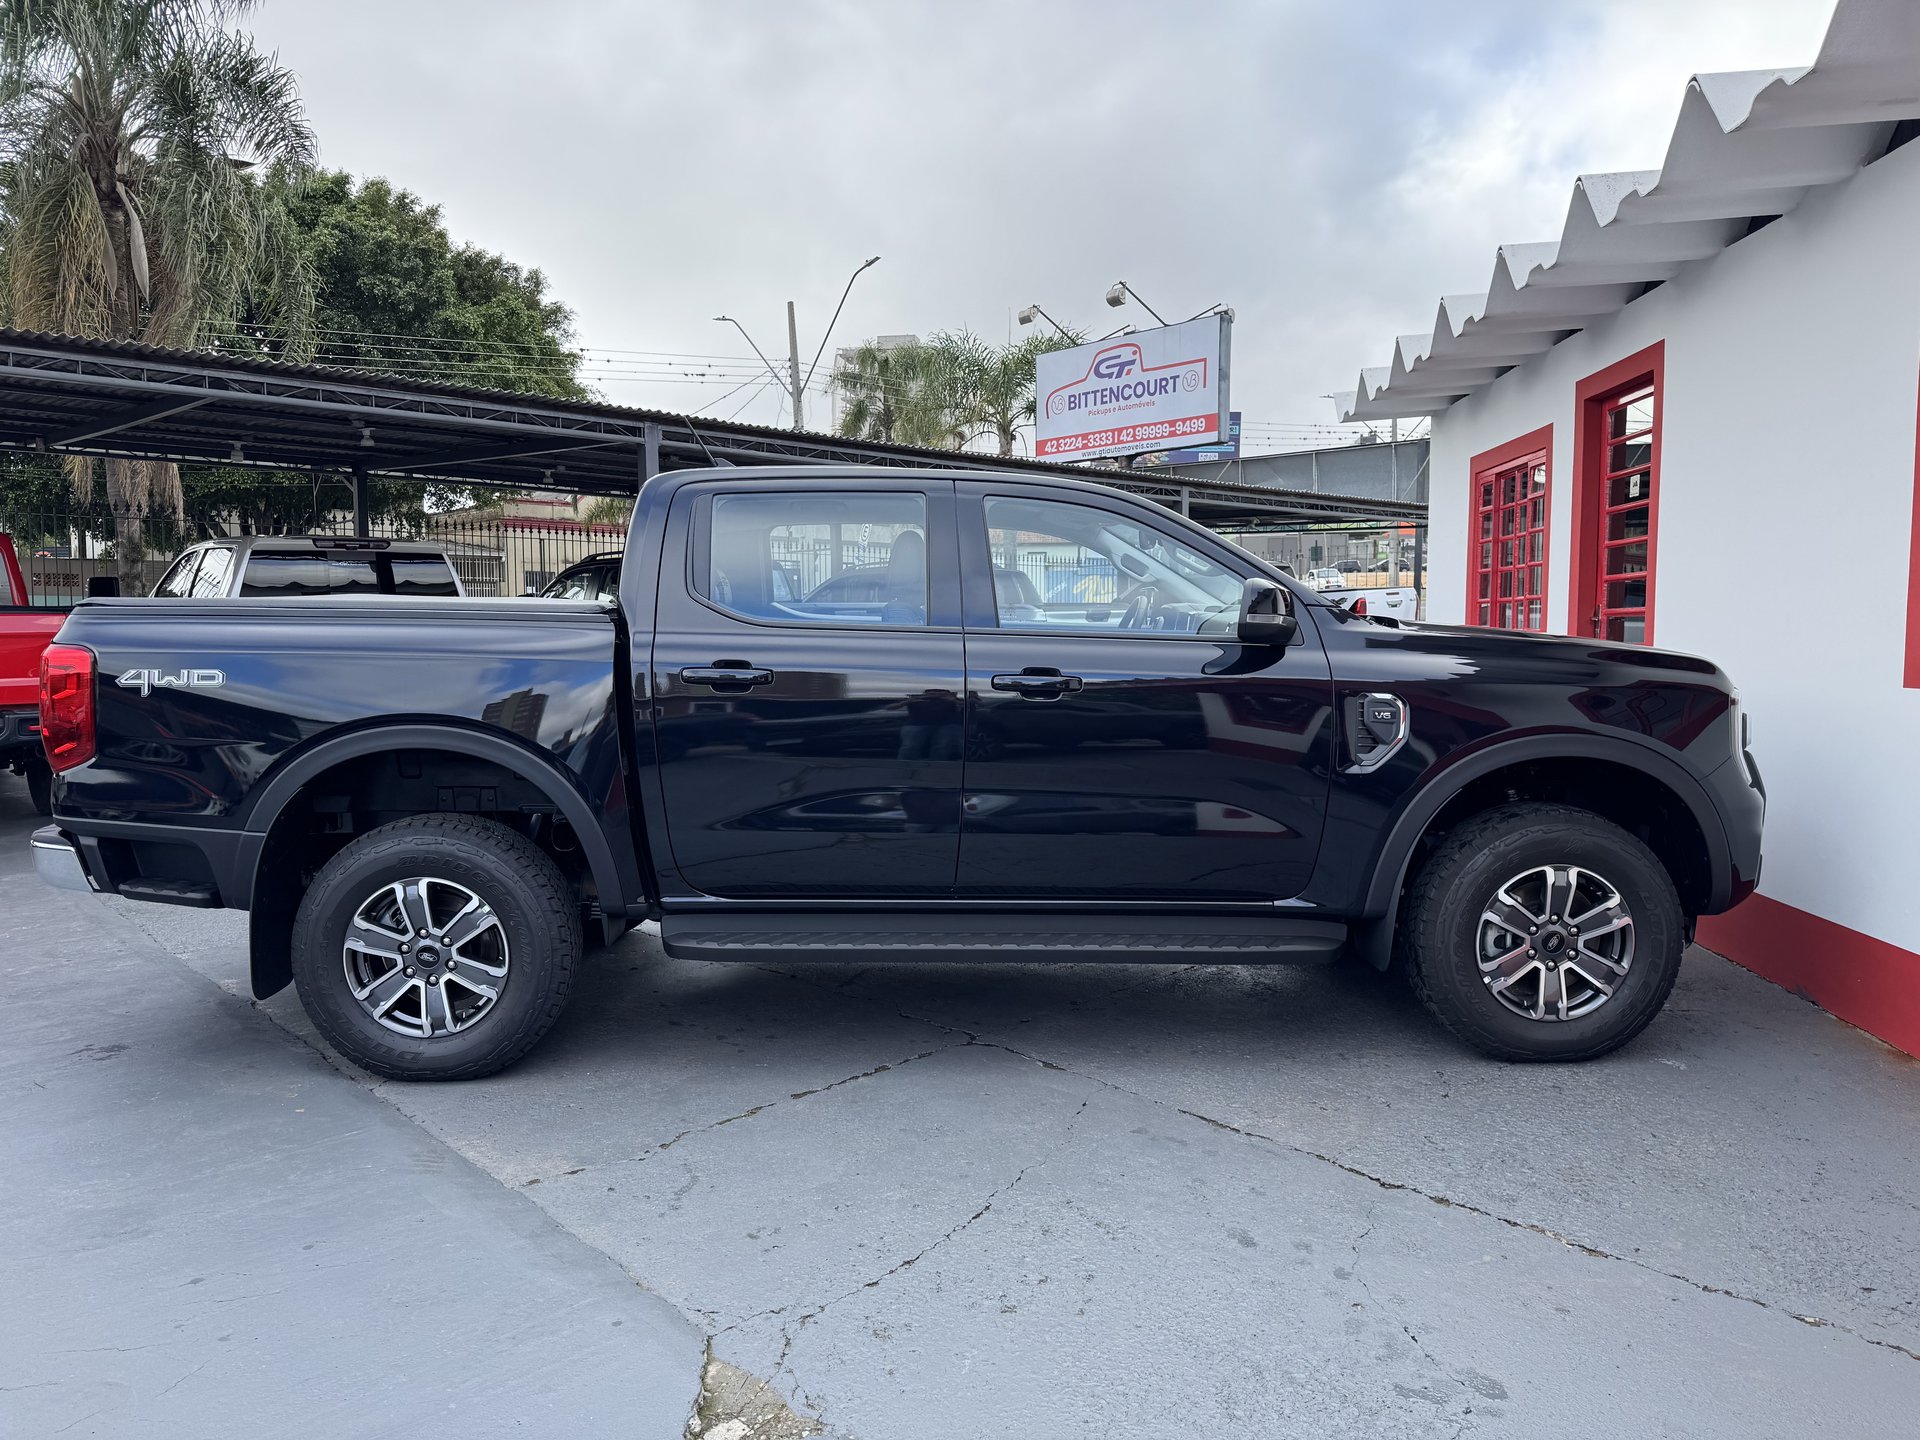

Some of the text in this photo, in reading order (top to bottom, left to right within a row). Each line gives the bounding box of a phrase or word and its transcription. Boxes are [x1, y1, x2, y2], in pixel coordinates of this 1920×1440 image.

[1067, 374, 1180, 411] BITTENCOURT
[1088, 407, 1112, 417] Pickups
[1117, 400, 1156, 412] Automóveis
[1045, 440, 1058, 453] 42
[1058, 431, 1113, 451] 3224-3333
[1120, 428, 1134, 442] 42
[1135, 417, 1206, 440] 99999-9499
[1081, 441, 1161, 458] www.gtiautomoveis.com
[115, 669, 226, 697] 4WD
[1374, 711, 1391, 719] V6
